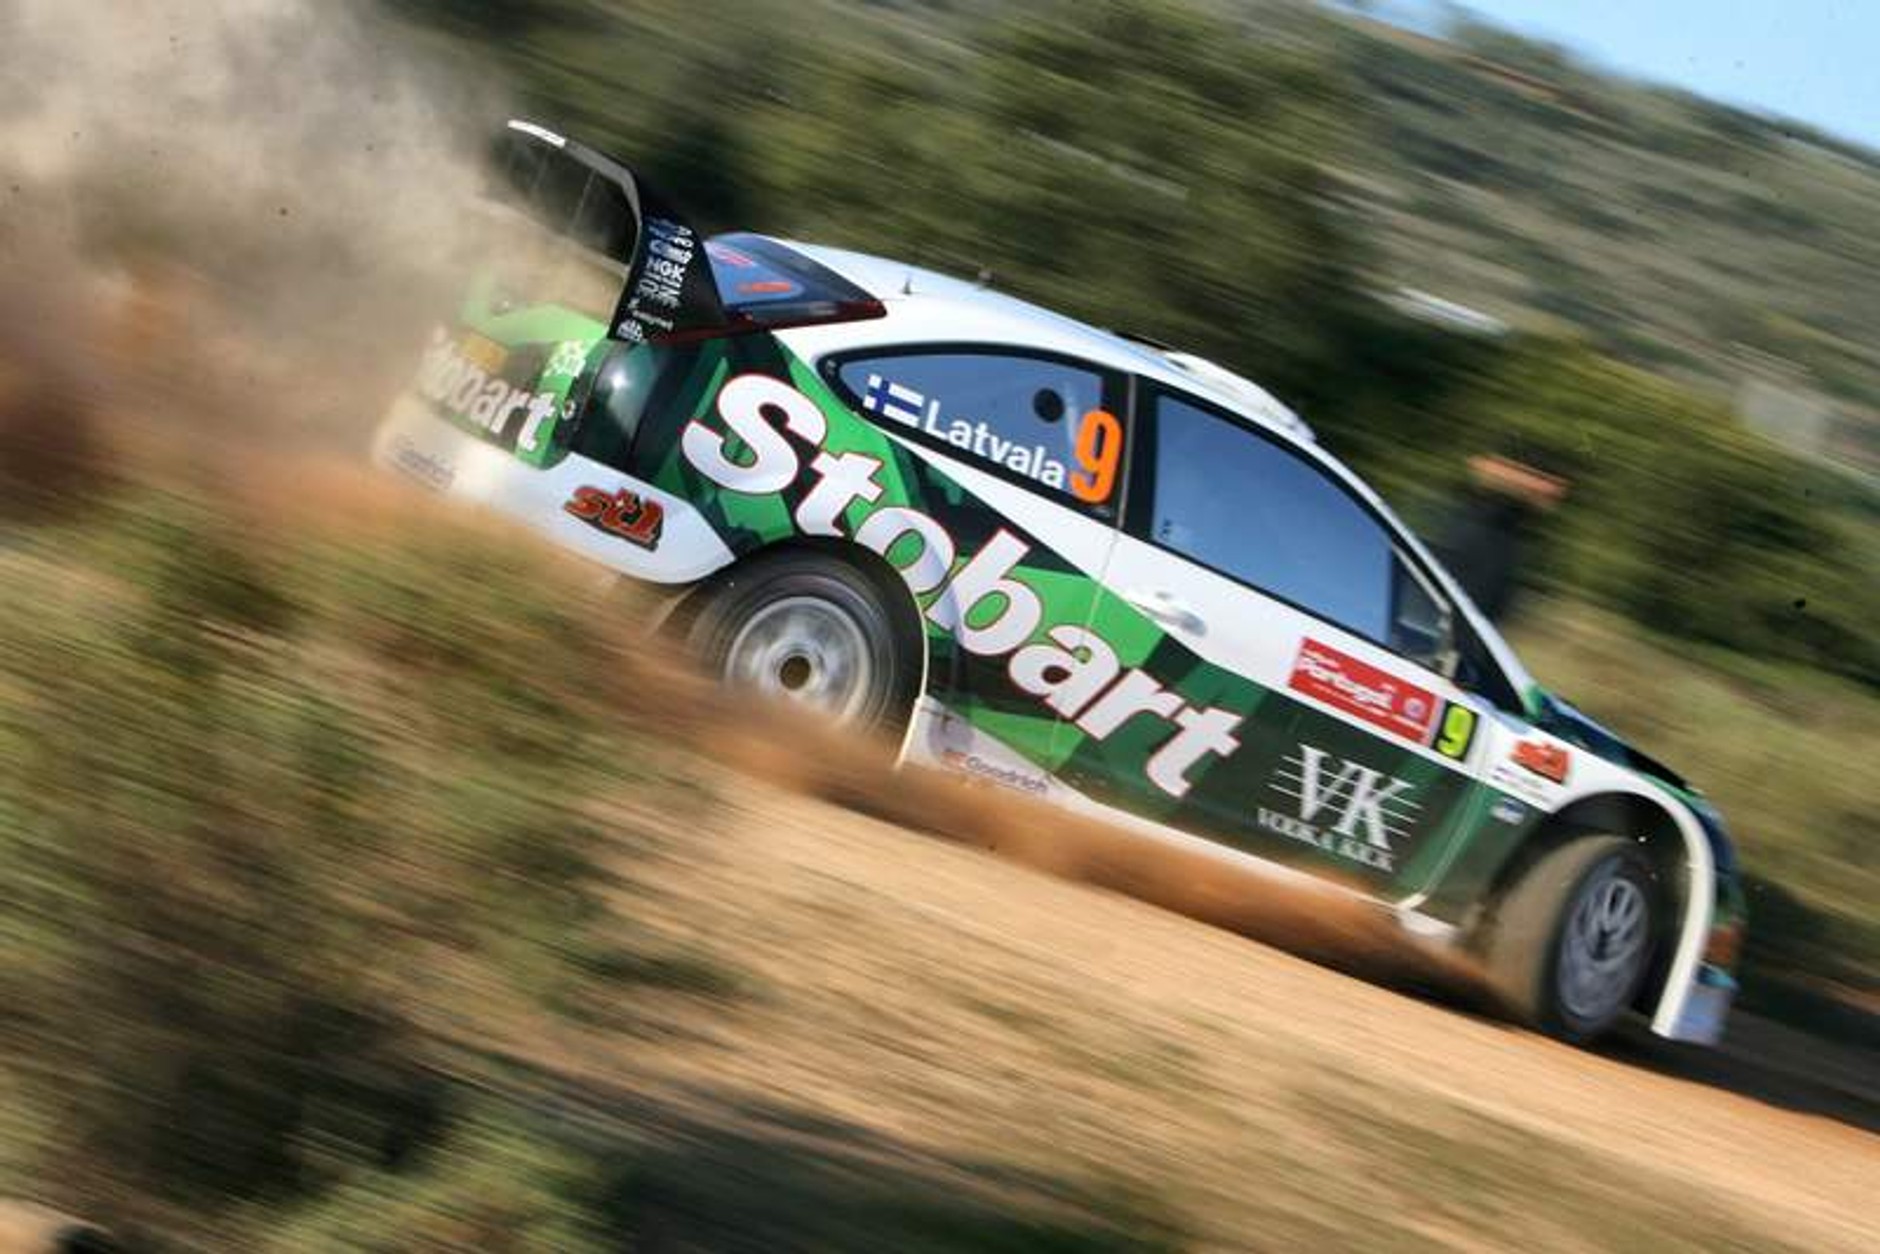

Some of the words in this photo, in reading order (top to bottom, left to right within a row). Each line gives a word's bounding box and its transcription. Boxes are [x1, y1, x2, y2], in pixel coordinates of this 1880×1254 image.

[924, 399, 1066, 490] Latvala
[1069, 409, 1124, 504] 9
[681, 372, 1243, 799] Stobart
[1439, 704, 1475, 758] 9
[1297, 742, 1417, 852] VK
